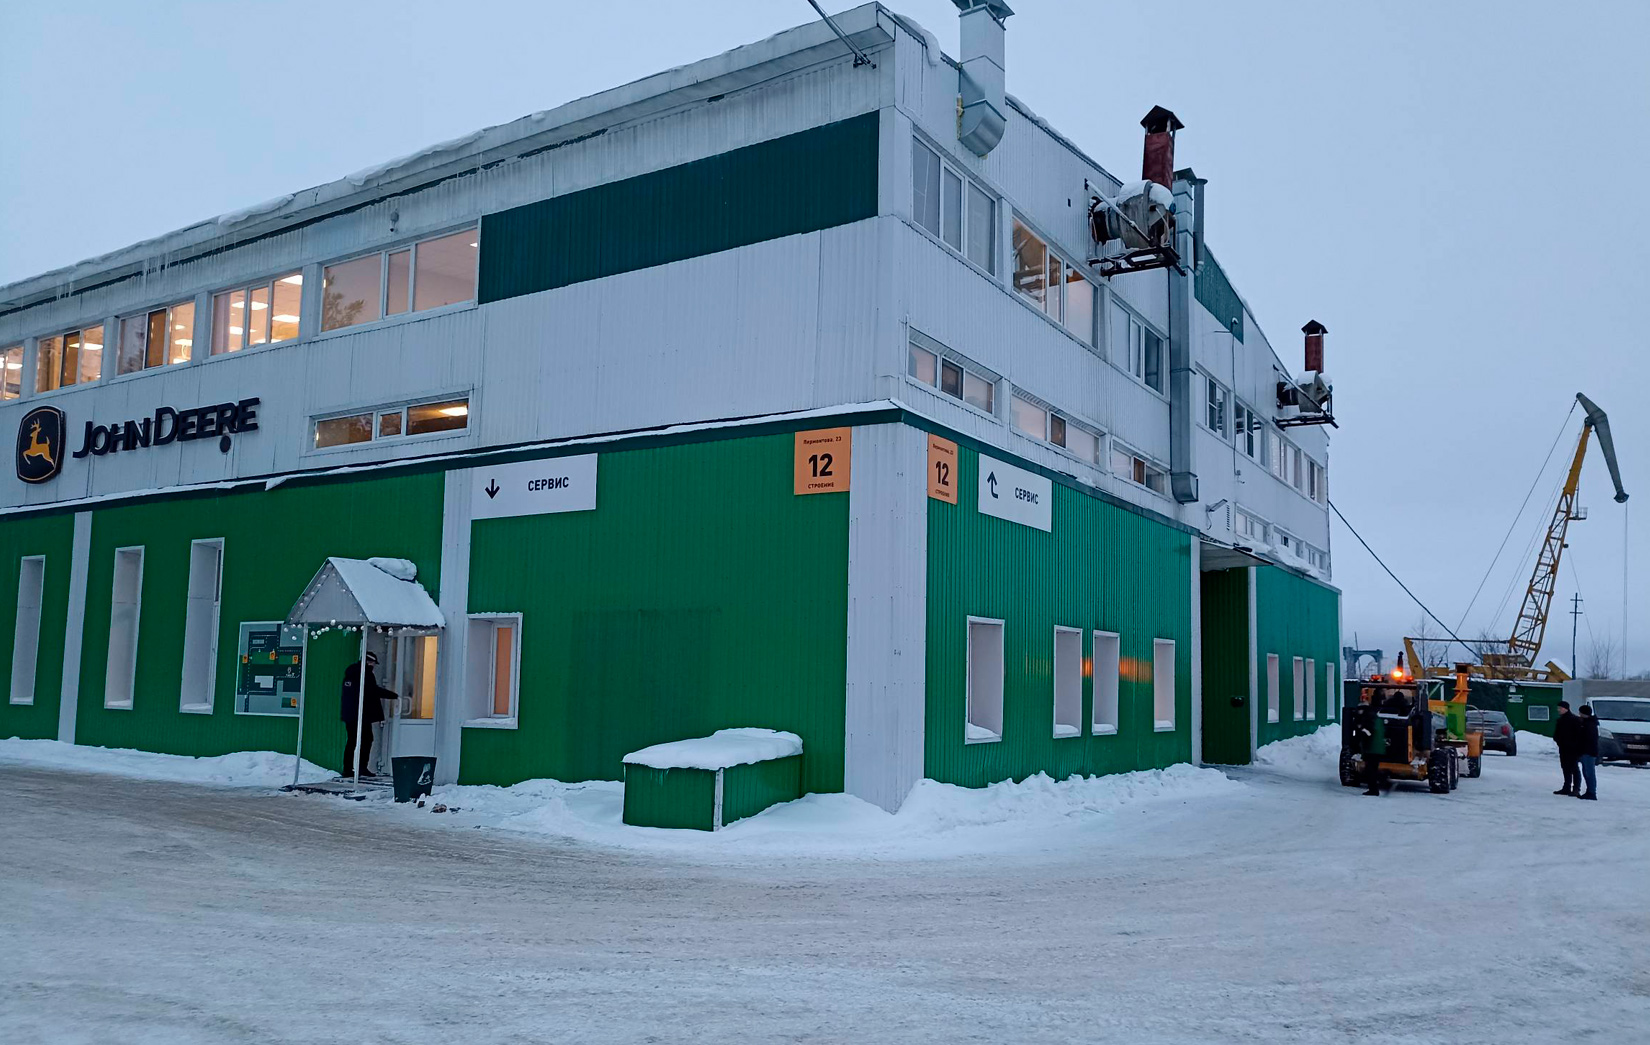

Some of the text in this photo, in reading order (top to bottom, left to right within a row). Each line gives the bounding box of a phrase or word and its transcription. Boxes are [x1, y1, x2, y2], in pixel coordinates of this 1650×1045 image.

[73, 397, 261, 459] JOHN DEERE
[808, 453, 833, 477] 12
[935, 461, 949, 486] 12
[528, 476, 569, 491] СЕРВИС
[807, 481, 834, 489] СТРОЕНИЕ
[1015, 487, 1039, 505] СЕРВИС
